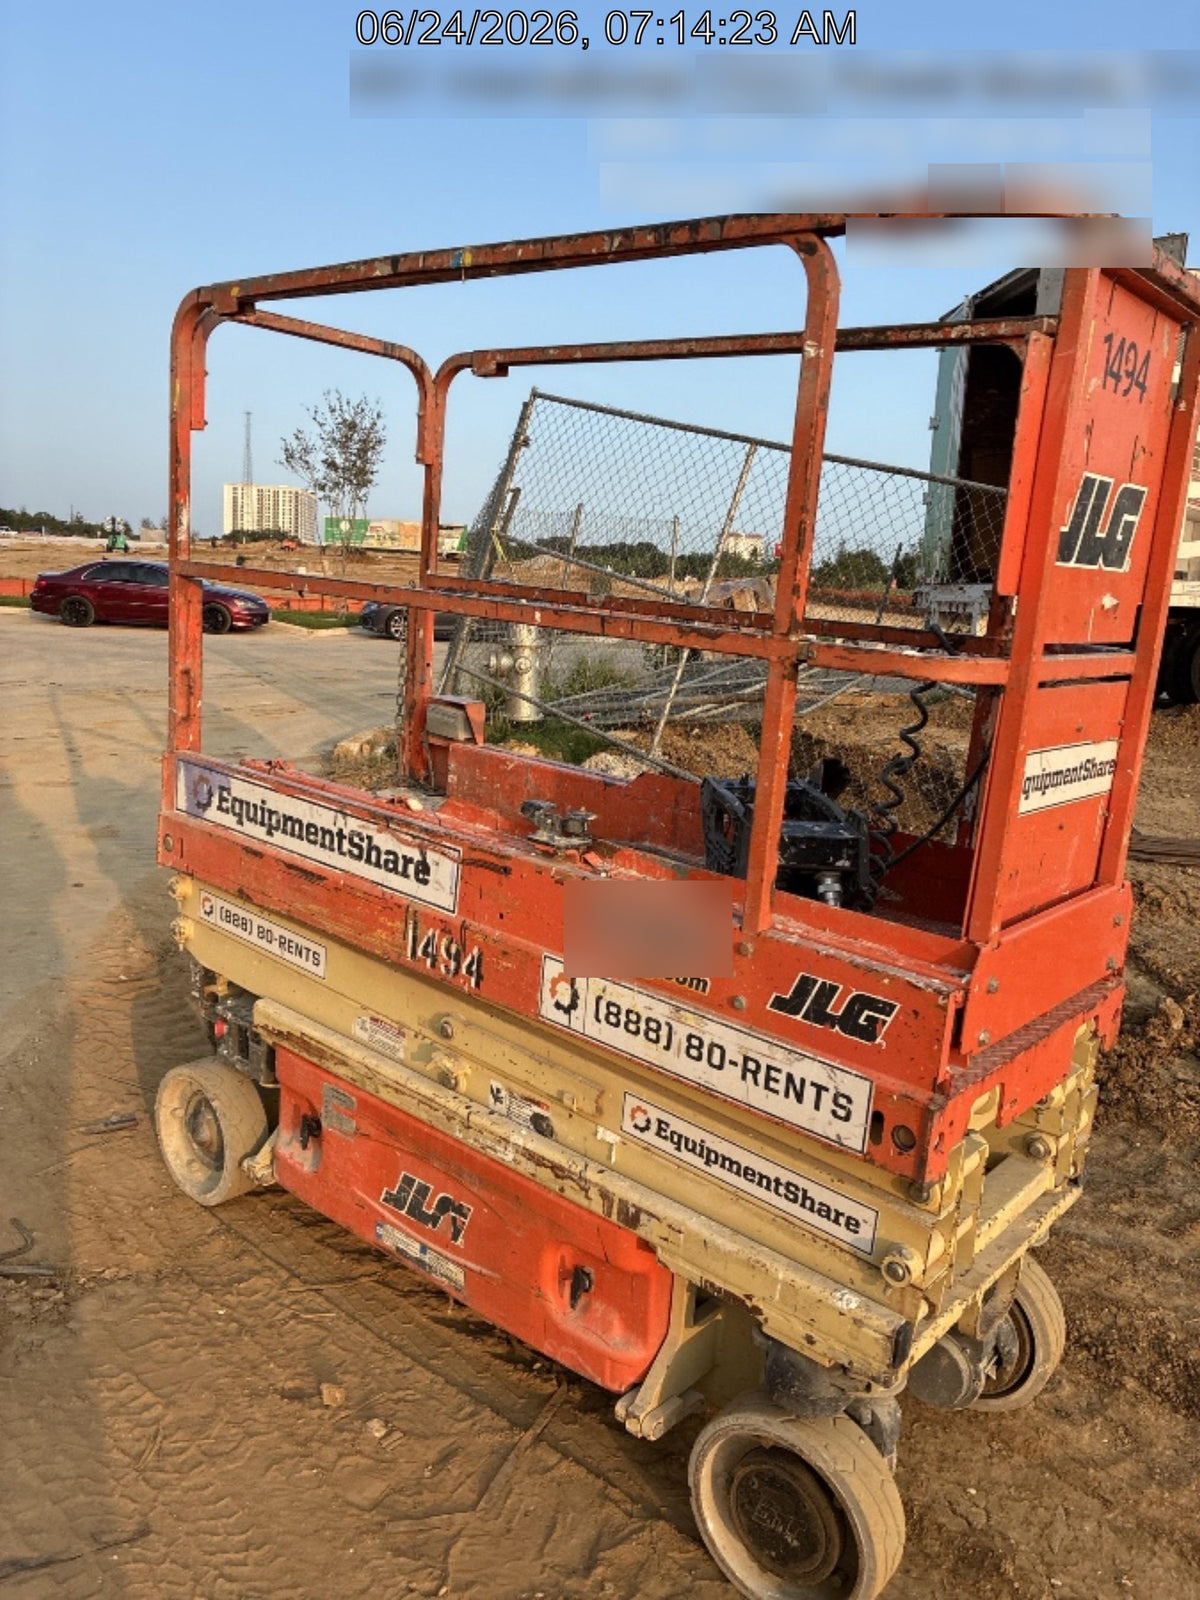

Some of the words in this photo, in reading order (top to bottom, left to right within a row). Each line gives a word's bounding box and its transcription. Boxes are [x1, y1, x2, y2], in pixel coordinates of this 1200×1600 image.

[1103, 332, 1151, 404] 1494
[1055, 471, 1148, 573] JLG
[1022, 757, 1117, 801] quipmentShare
[216, 786, 432, 886] EquipmentShare
[219, 905, 253, 936] (888)
[257, 926, 322, 967] 80-RENTS
[406, 908, 484, 990] 1494
[767, 972, 900, 1046] JLG
[594, 995, 674, 1052] (888)
[685, 1033, 854, 1123] 80-RENTS
[655, 1121, 861, 1235] EquipmentShare
